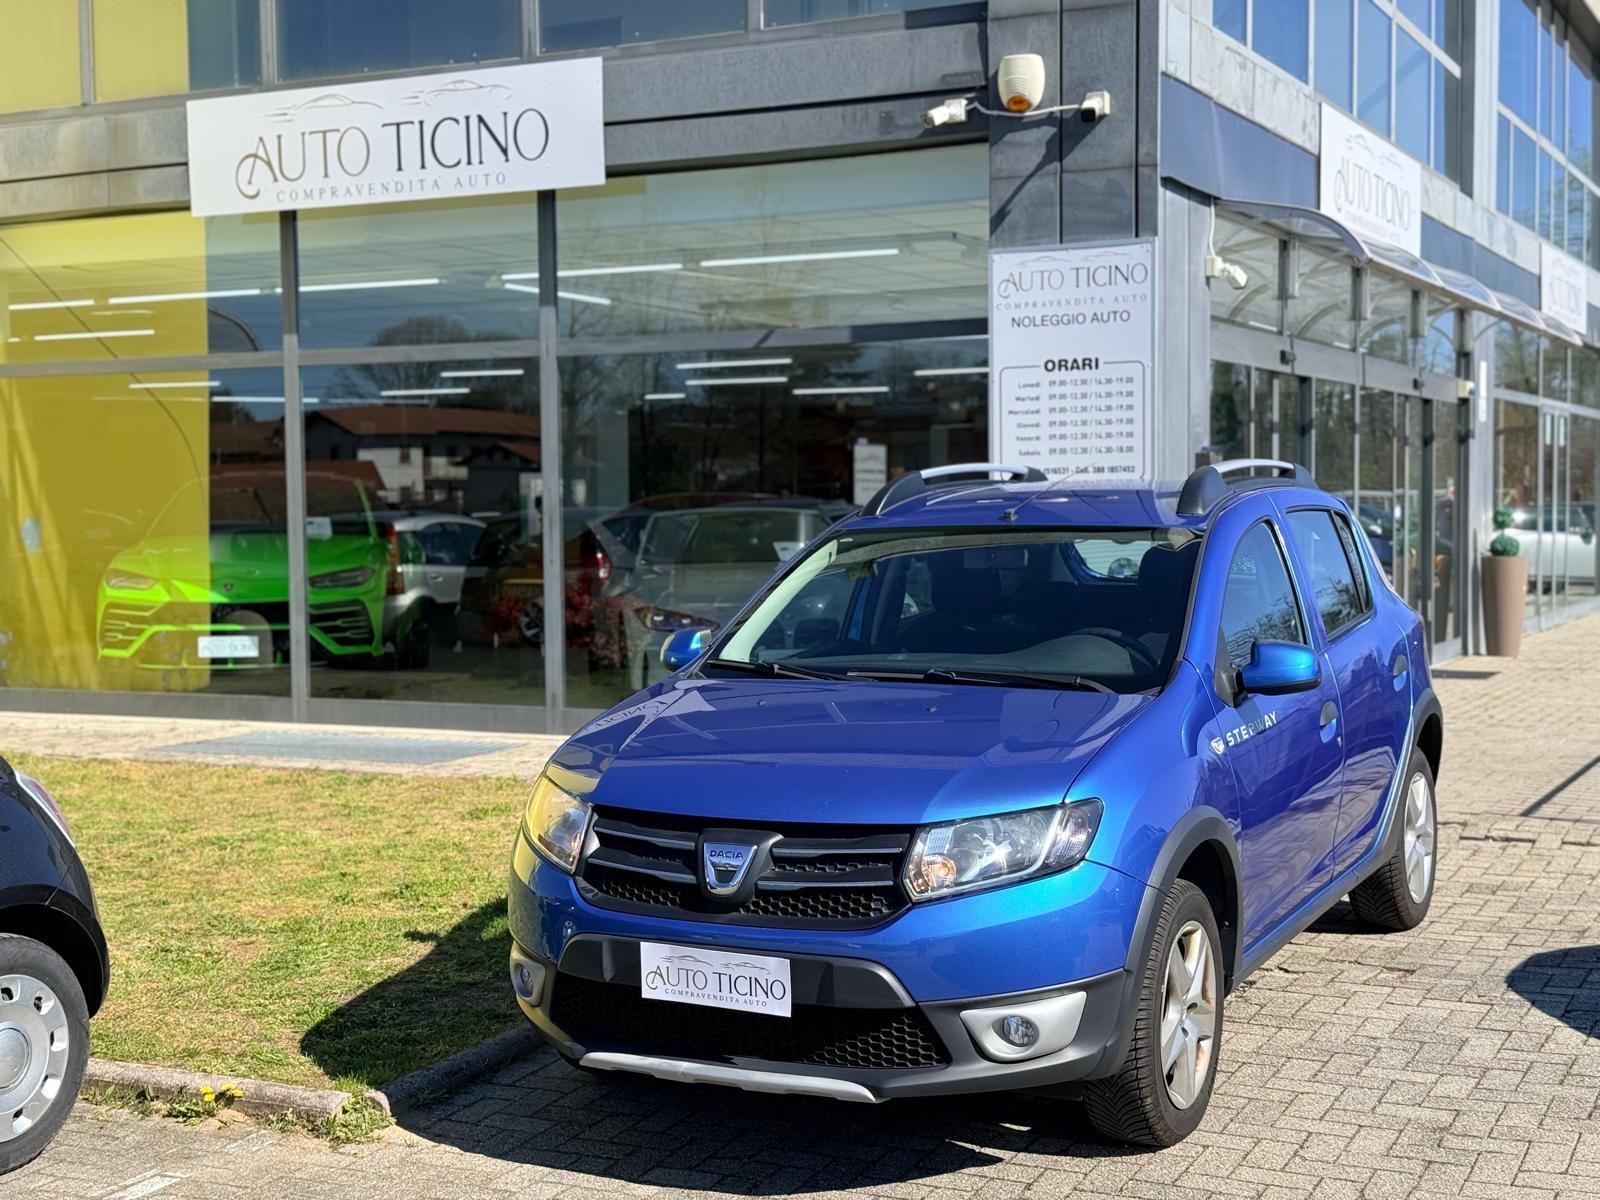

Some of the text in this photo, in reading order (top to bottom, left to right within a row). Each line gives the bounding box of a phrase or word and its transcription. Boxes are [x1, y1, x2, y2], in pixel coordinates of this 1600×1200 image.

[235, 108, 549, 200] AUTO TICINO
[276, 172, 507, 203] COMPRAVENDITA AUTO
[997, 262, 1148, 299] AUTO TICINO
[996, 293, 1147, 311] COMPRAVENDITA AUTO
[1011, 310, 1131, 328] NOLEGGIO AUTO
[1044, 357, 1099, 372] ORARI
[1226, 710, 1277, 747] STEPWAY
[709, 850, 744, 860] DACIA
[645, 965, 786, 1000] AUTO TICINO
[664, 988, 767, 1007] COMPRAVENDITA AUTO
